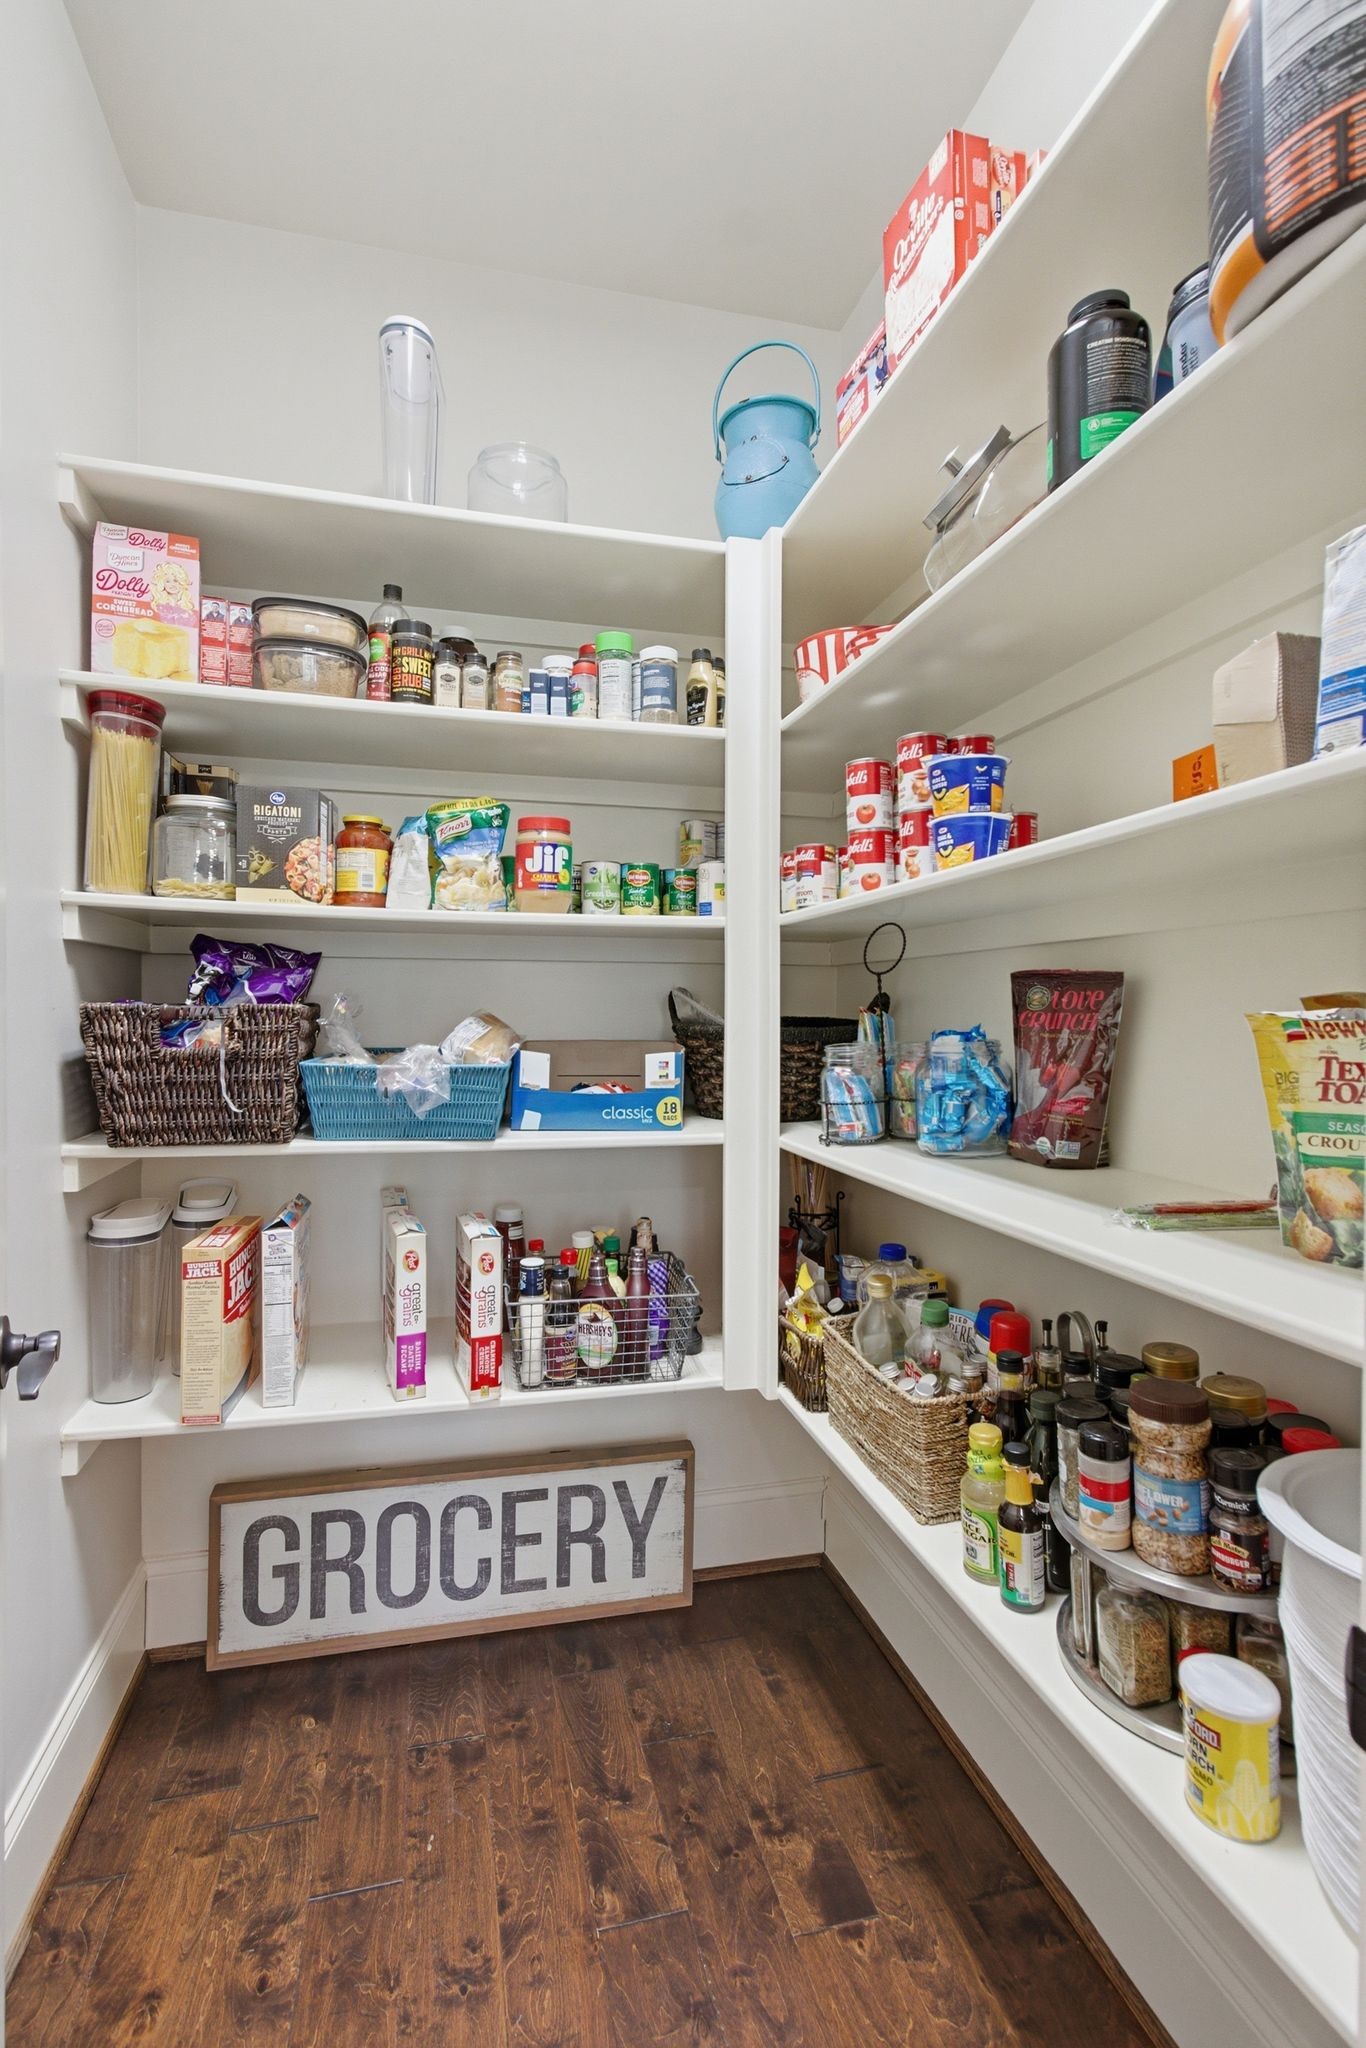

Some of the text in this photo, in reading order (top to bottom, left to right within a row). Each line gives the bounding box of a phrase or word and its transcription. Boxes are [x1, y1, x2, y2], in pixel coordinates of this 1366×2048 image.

[129, 532, 166, 552] Dolly
[96, 569, 150, 598] Dolly
[96, 602, 154, 616] CORNBREAD
[402, 647, 424, 659] GRILL
[402, 657, 432, 678] SWEET
[402, 673, 422, 688] RUB
[253, 804, 302, 817] RIGATONI
[439, 818, 470, 838] Knorr
[525, 844, 569, 873] Jif
[1318, 1055, 1366, 1082] TEX
[602, 1106, 653, 1120] classic
[662, 1102, 677, 1114] 18
[1307, 1135, 1366, 1151] CROU
[186, 1261, 218, 1269] HUNGRY
[186, 1267, 222, 1278] JACK
[399, 1289, 413, 1327] grains
[407, 1282, 423, 1316] great
[482, 1284, 496, 1316] great
[474, 1290, 488, 1329] grains
[243, 1476, 668, 1626] GROCERY
